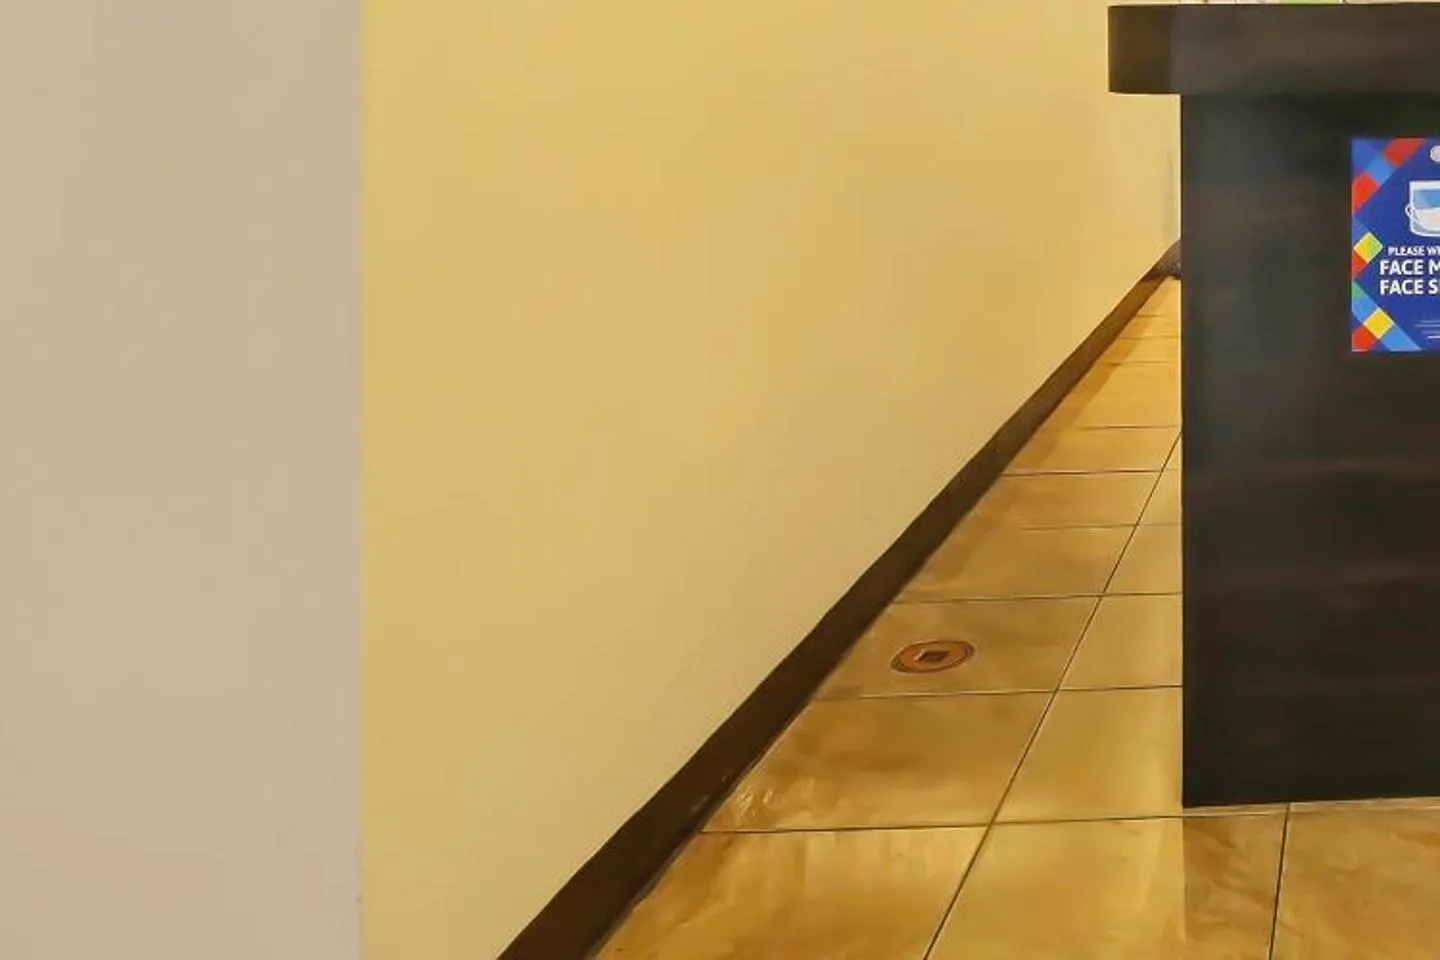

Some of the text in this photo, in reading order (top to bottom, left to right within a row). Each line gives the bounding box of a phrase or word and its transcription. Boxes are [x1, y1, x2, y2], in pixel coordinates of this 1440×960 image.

[1388, 246, 1424, 256] PLEASE
[1380, 260, 1424, 275] FACE
[1380, 280, 1424, 295] FACE
